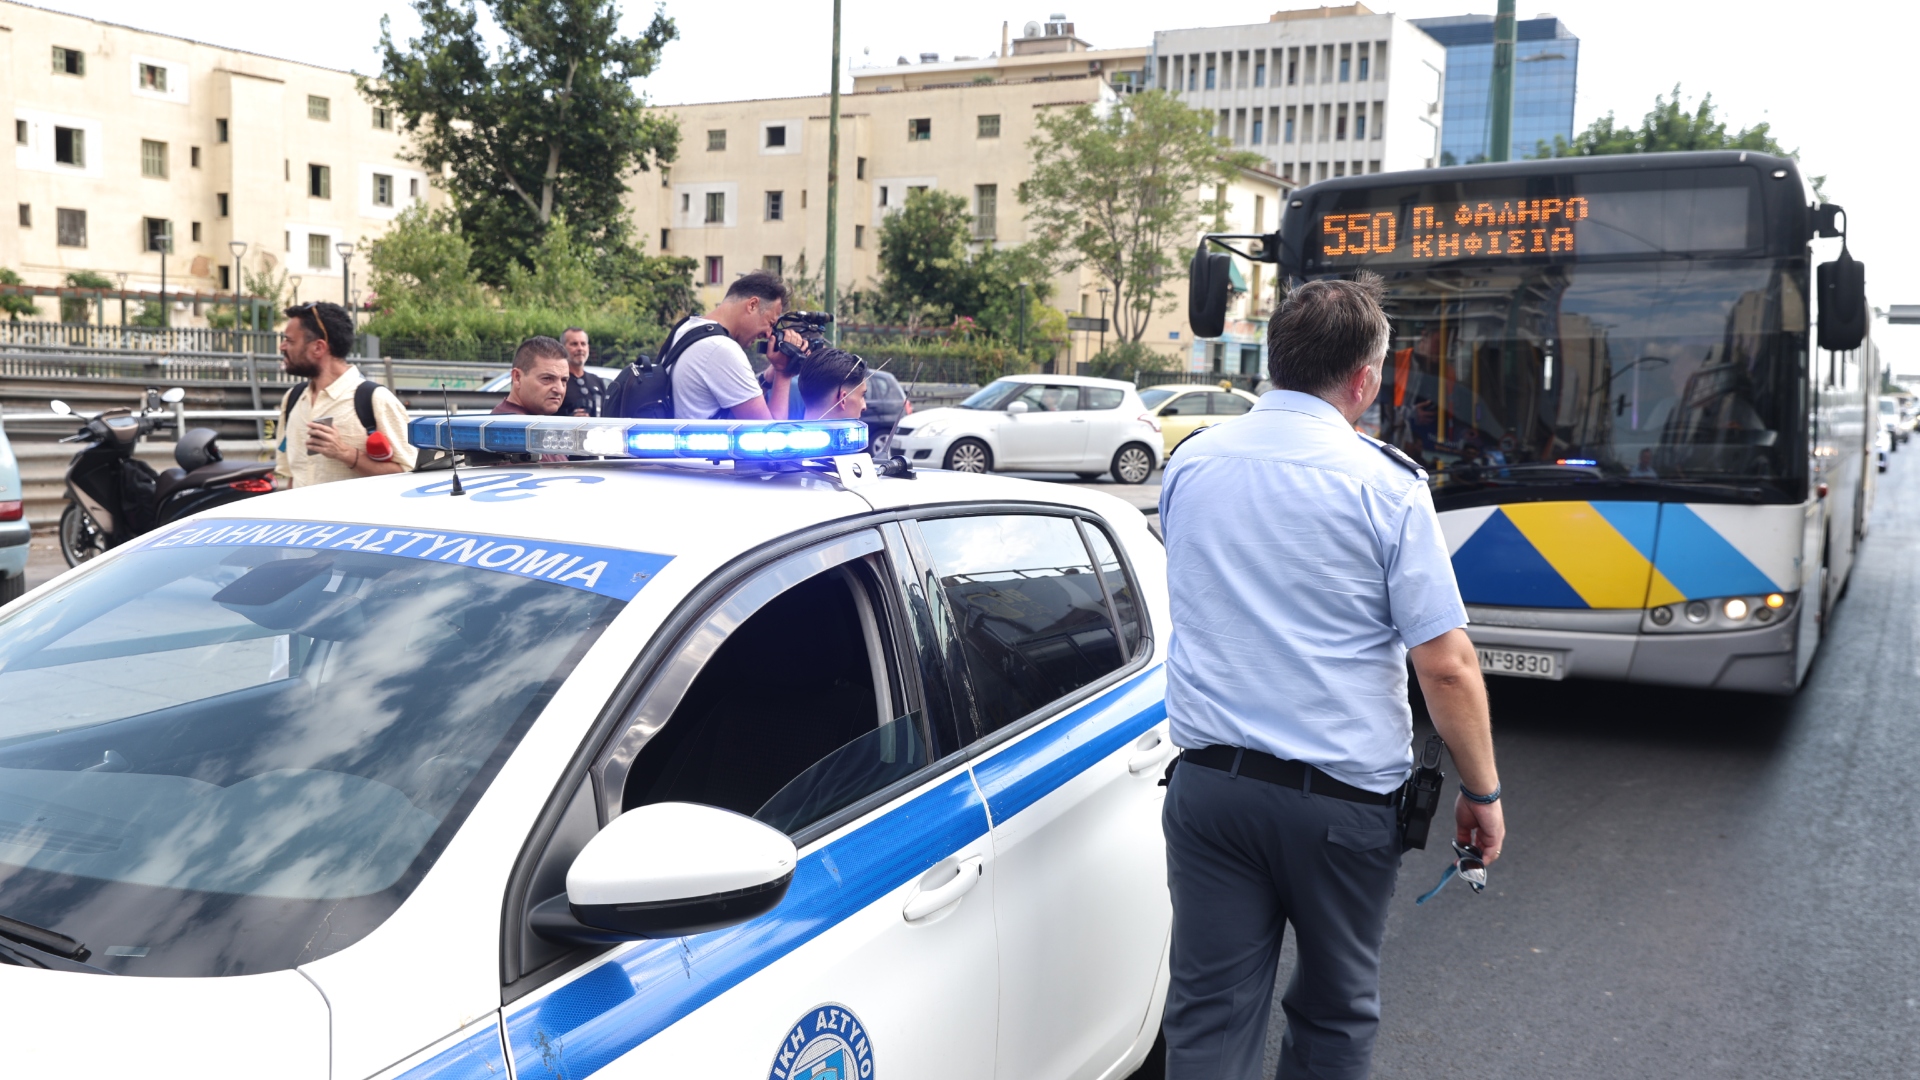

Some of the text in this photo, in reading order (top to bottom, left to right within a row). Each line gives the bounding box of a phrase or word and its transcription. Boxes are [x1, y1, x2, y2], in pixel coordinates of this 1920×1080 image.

[1413, 197, 1589, 229] Π. ΦΑΛΗΡΟ
[1323, 212, 1396, 256] 550
[1412, 227, 1574, 258] ΚΗΦΙΣΙΑ
[152, 524, 609, 588] ΕΛΛΗΝΙΚΗ ΑΣΤΥΝΟΜΙΑ
[1477, 650, 1551, 674] N-9830
